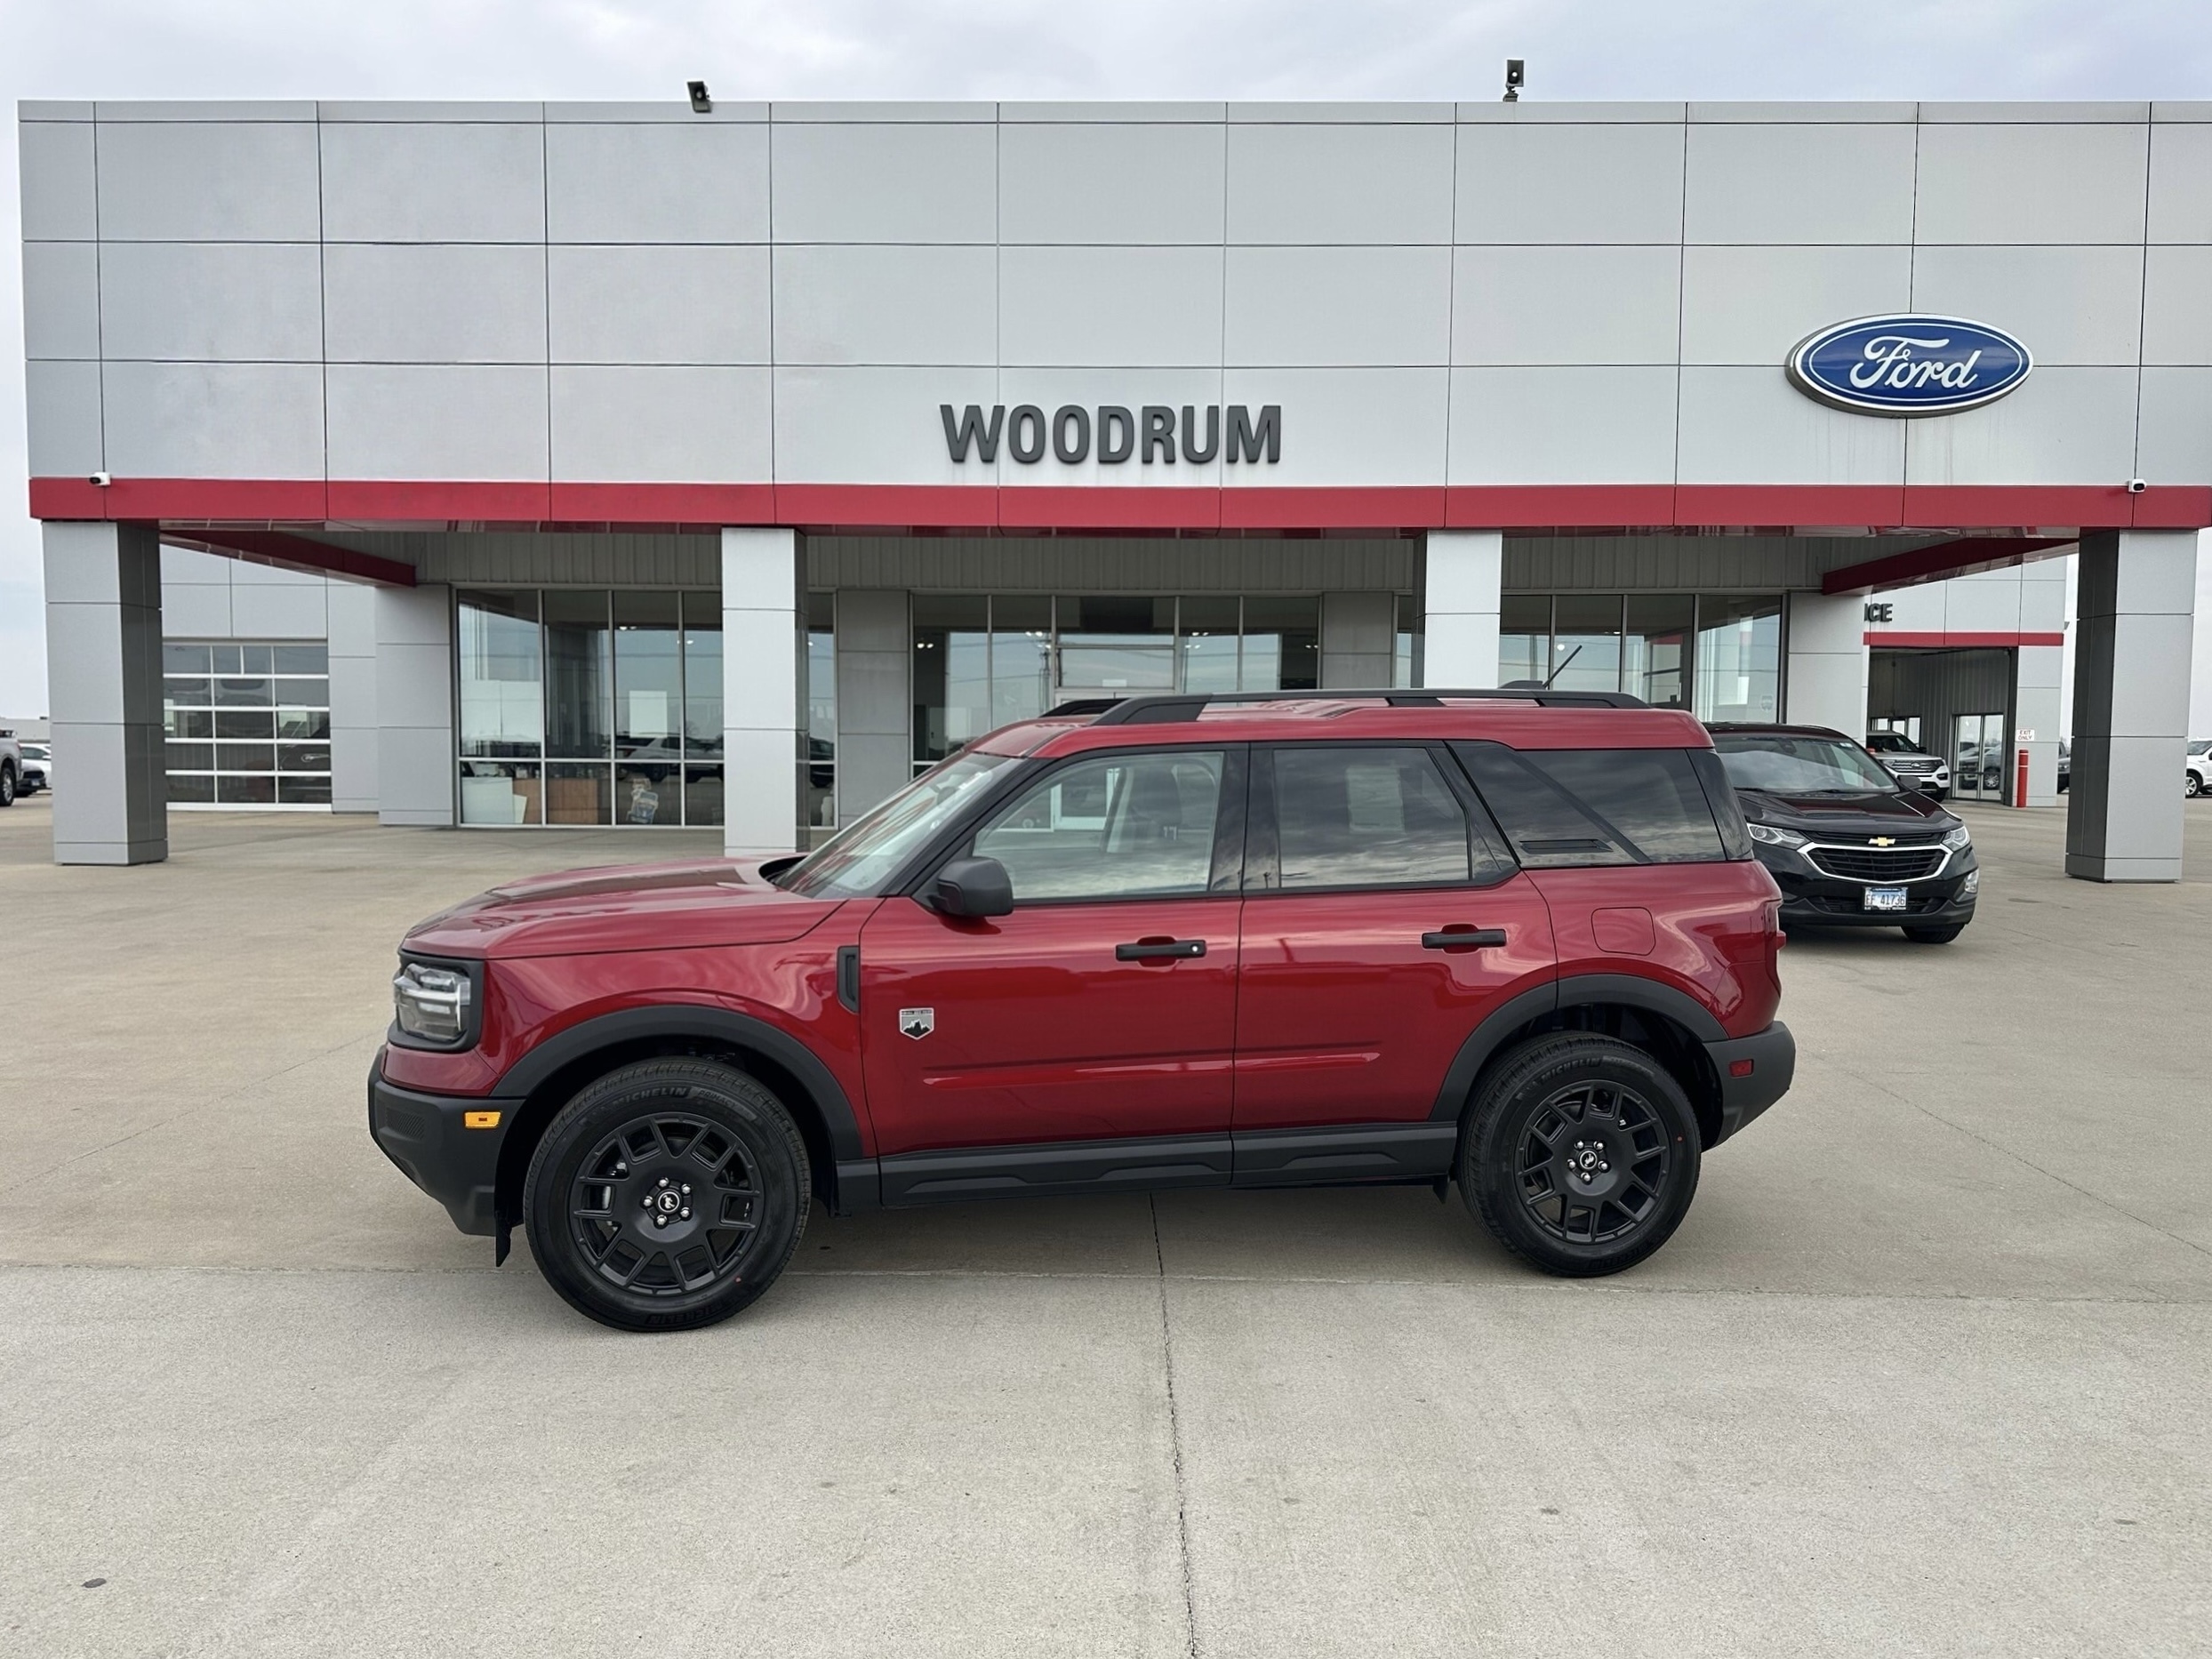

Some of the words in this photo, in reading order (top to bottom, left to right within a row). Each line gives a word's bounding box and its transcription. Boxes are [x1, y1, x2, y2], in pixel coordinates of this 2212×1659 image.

[1849, 336, 1982, 389] Ford
[940, 404, 1281, 465] WOODRUM
[1541, 1057, 1600, 1082] MICHELIN
[613, 1086, 686, 1106] MICHELIN
[698, 1090, 738, 1109] PRIMACY
